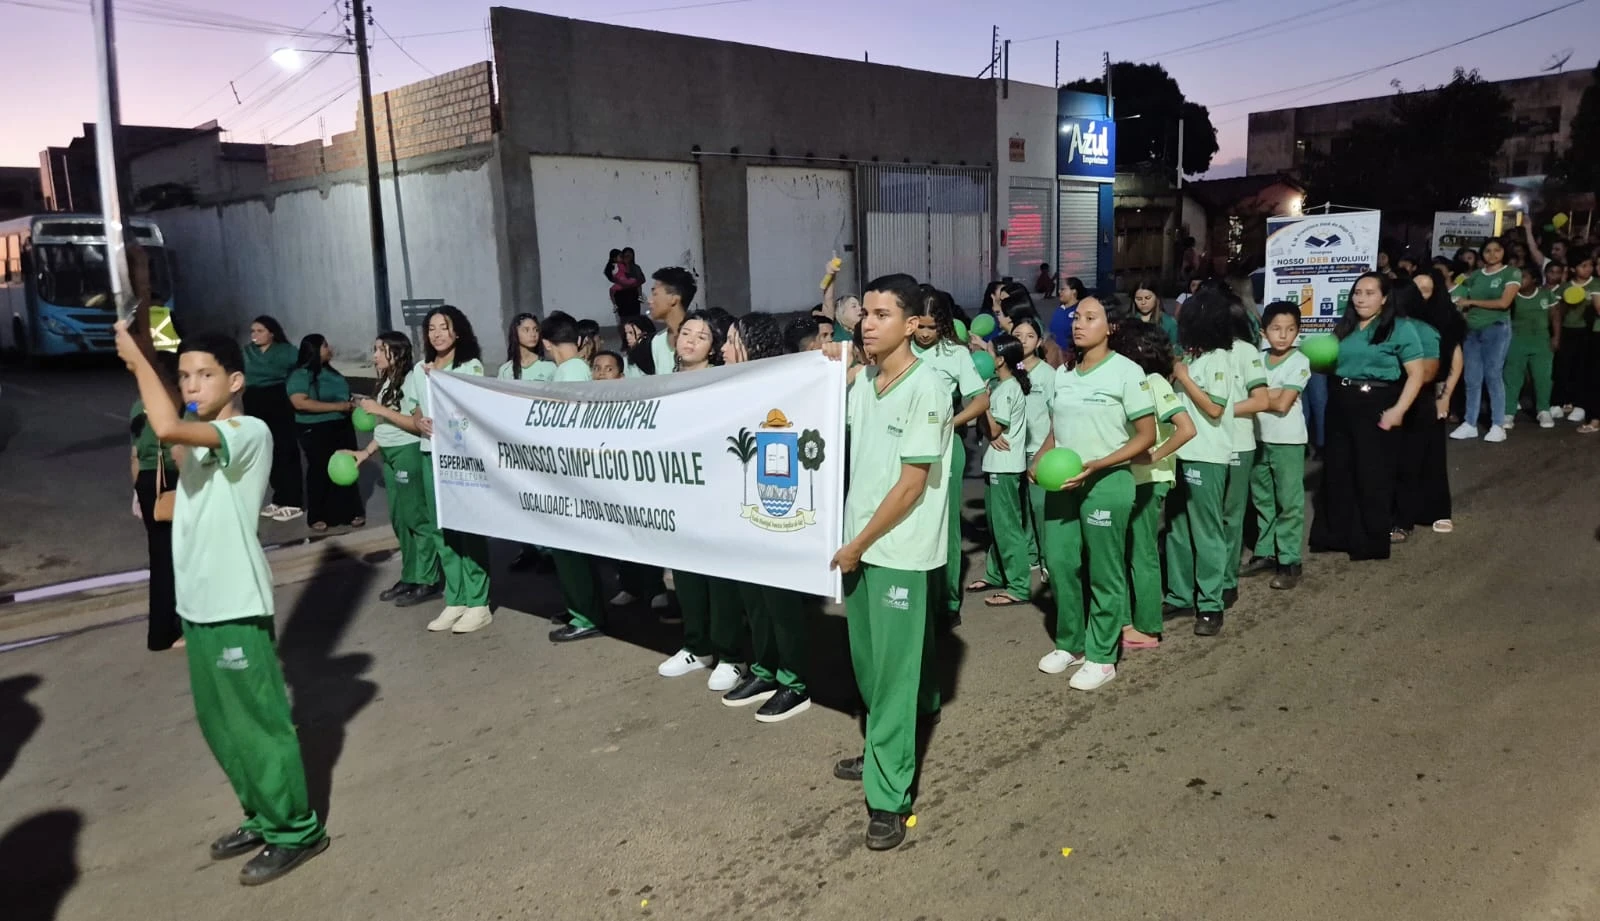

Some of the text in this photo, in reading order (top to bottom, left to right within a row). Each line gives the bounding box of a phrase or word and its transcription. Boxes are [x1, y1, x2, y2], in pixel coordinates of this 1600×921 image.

[1306, 256, 1329, 264] IDEB
[1331, 255, 1369, 264] EVOLUIU!
[525, 399, 660, 430] ESCOLA MUNICIPAL
[439, 454, 486, 473] ESPERANTINA
[497, 441, 706, 486] FRANCISCO SIMPLÍCIO DO VALE
[518, 491, 676, 533] LOCALIDADE: LAGOA DOS MACACOS
